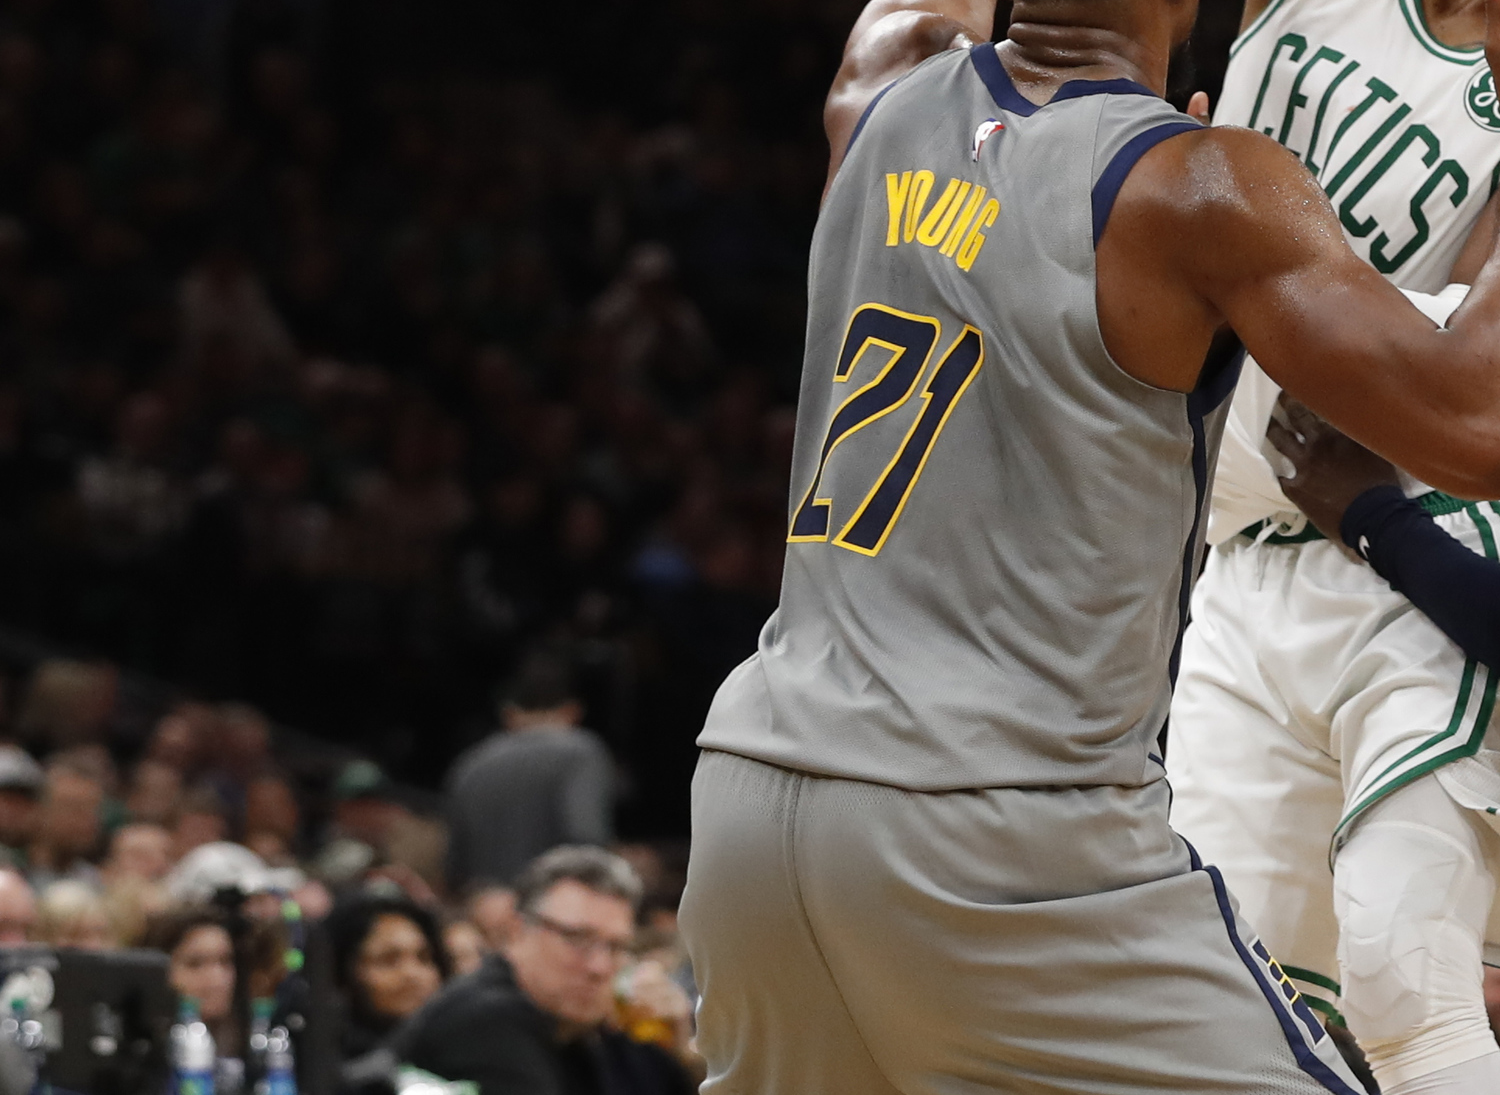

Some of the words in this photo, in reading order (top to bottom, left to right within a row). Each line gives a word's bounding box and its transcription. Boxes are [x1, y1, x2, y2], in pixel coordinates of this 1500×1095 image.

[886, 170, 1001, 272] YOUNG
[1248, 32, 1469, 274] CELTICS
[786, 302, 985, 557] 21
